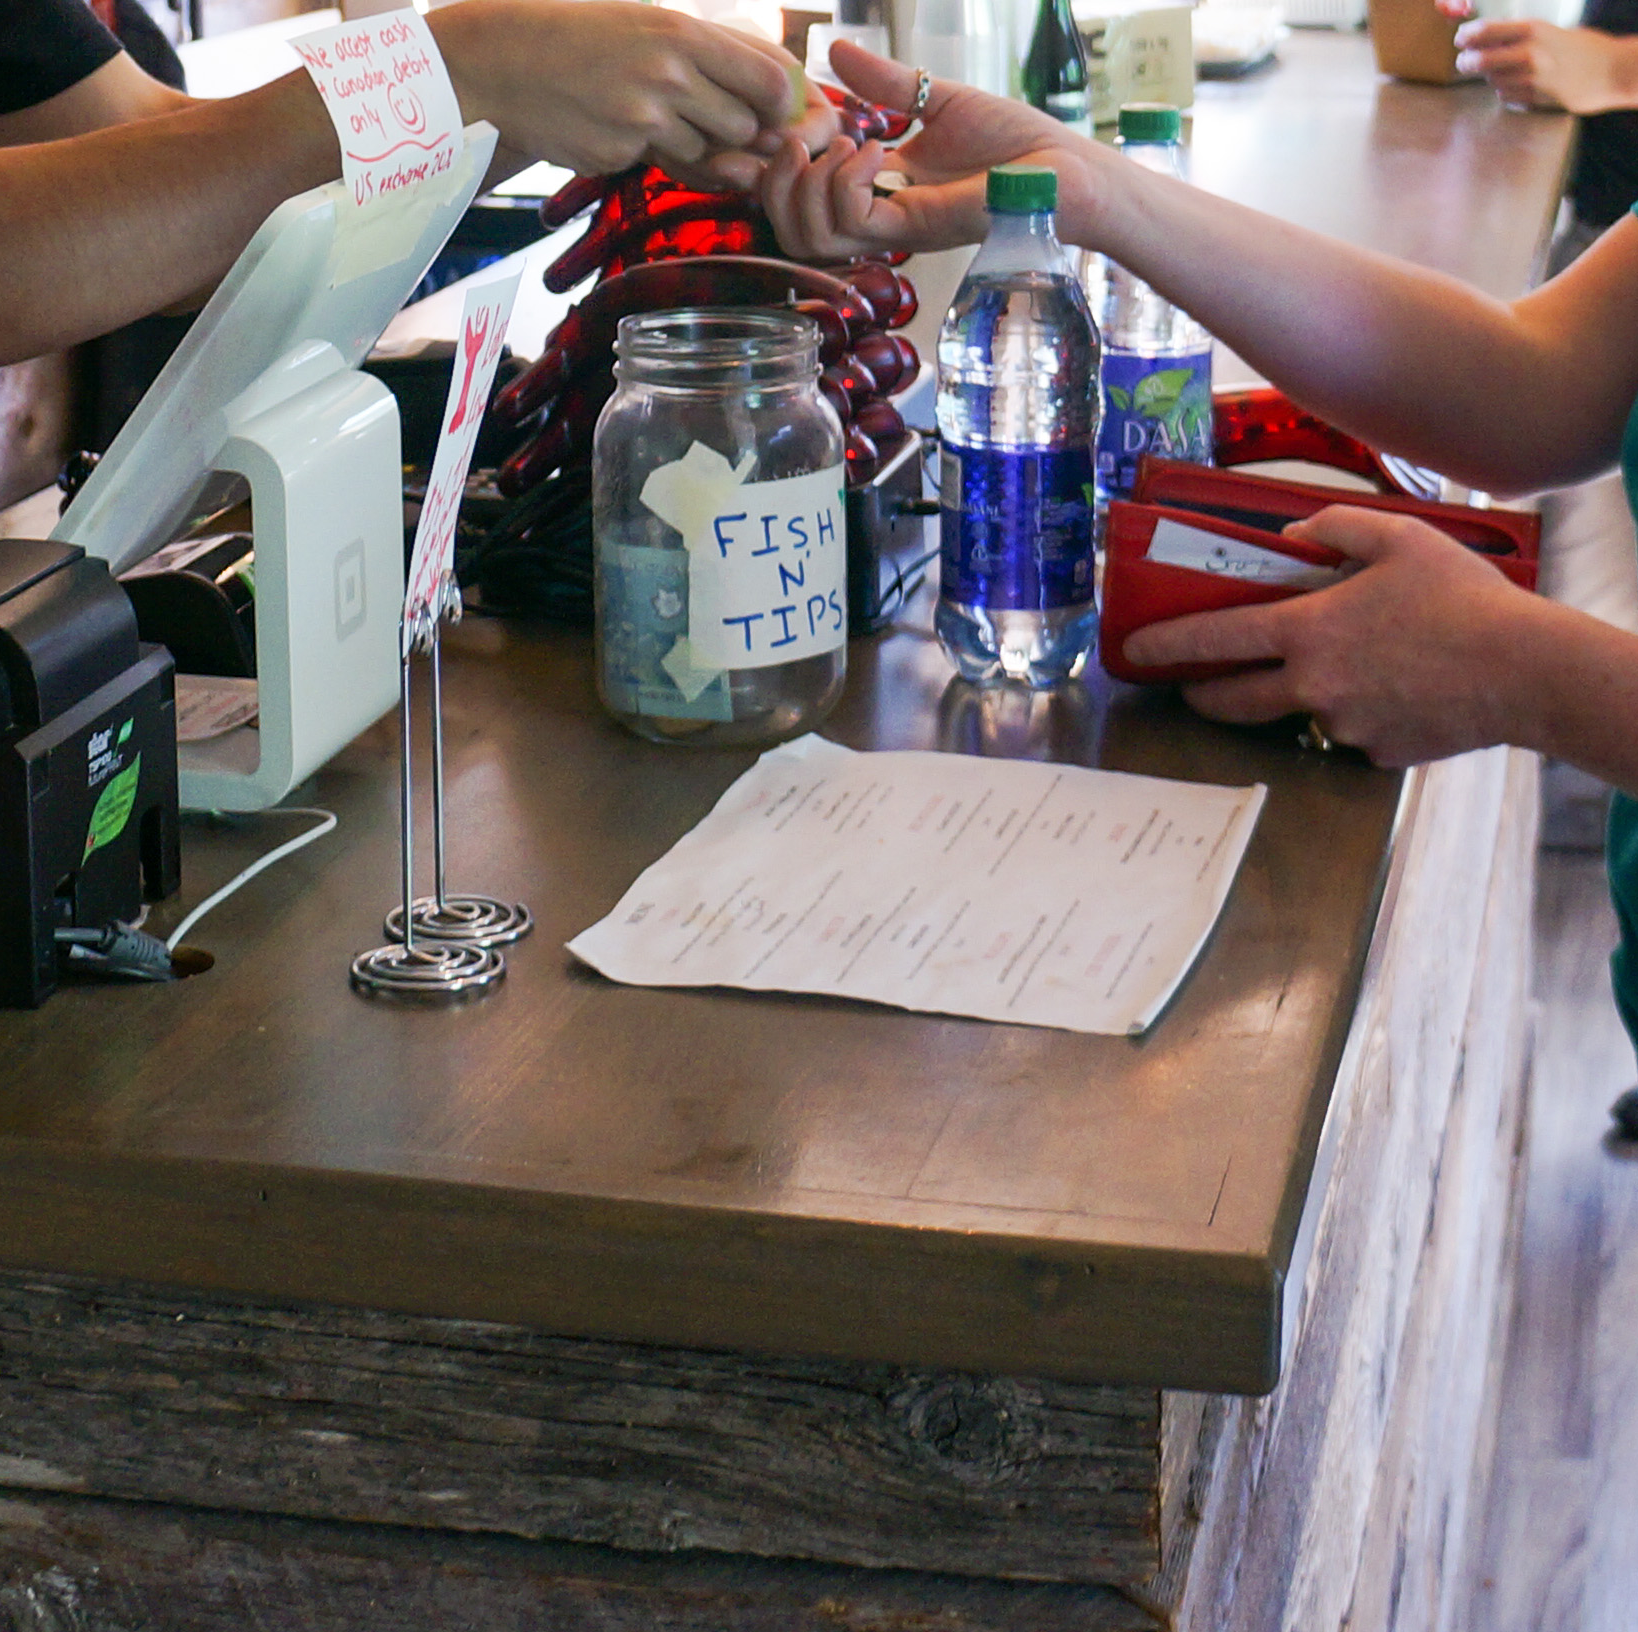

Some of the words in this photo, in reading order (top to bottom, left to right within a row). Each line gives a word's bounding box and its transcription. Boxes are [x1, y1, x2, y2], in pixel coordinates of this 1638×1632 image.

[294, 43, 333, 70] We
[334, 29, 375, 66] accept
[378, 16, 417, 48] cash
[393, 47, 434, 84] debit
[349, 101, 389, 141] only
[354, 171, 374, 207] US
[712, 507, 836, 558] FISH
[721, 593, 845, 652] TIPS
